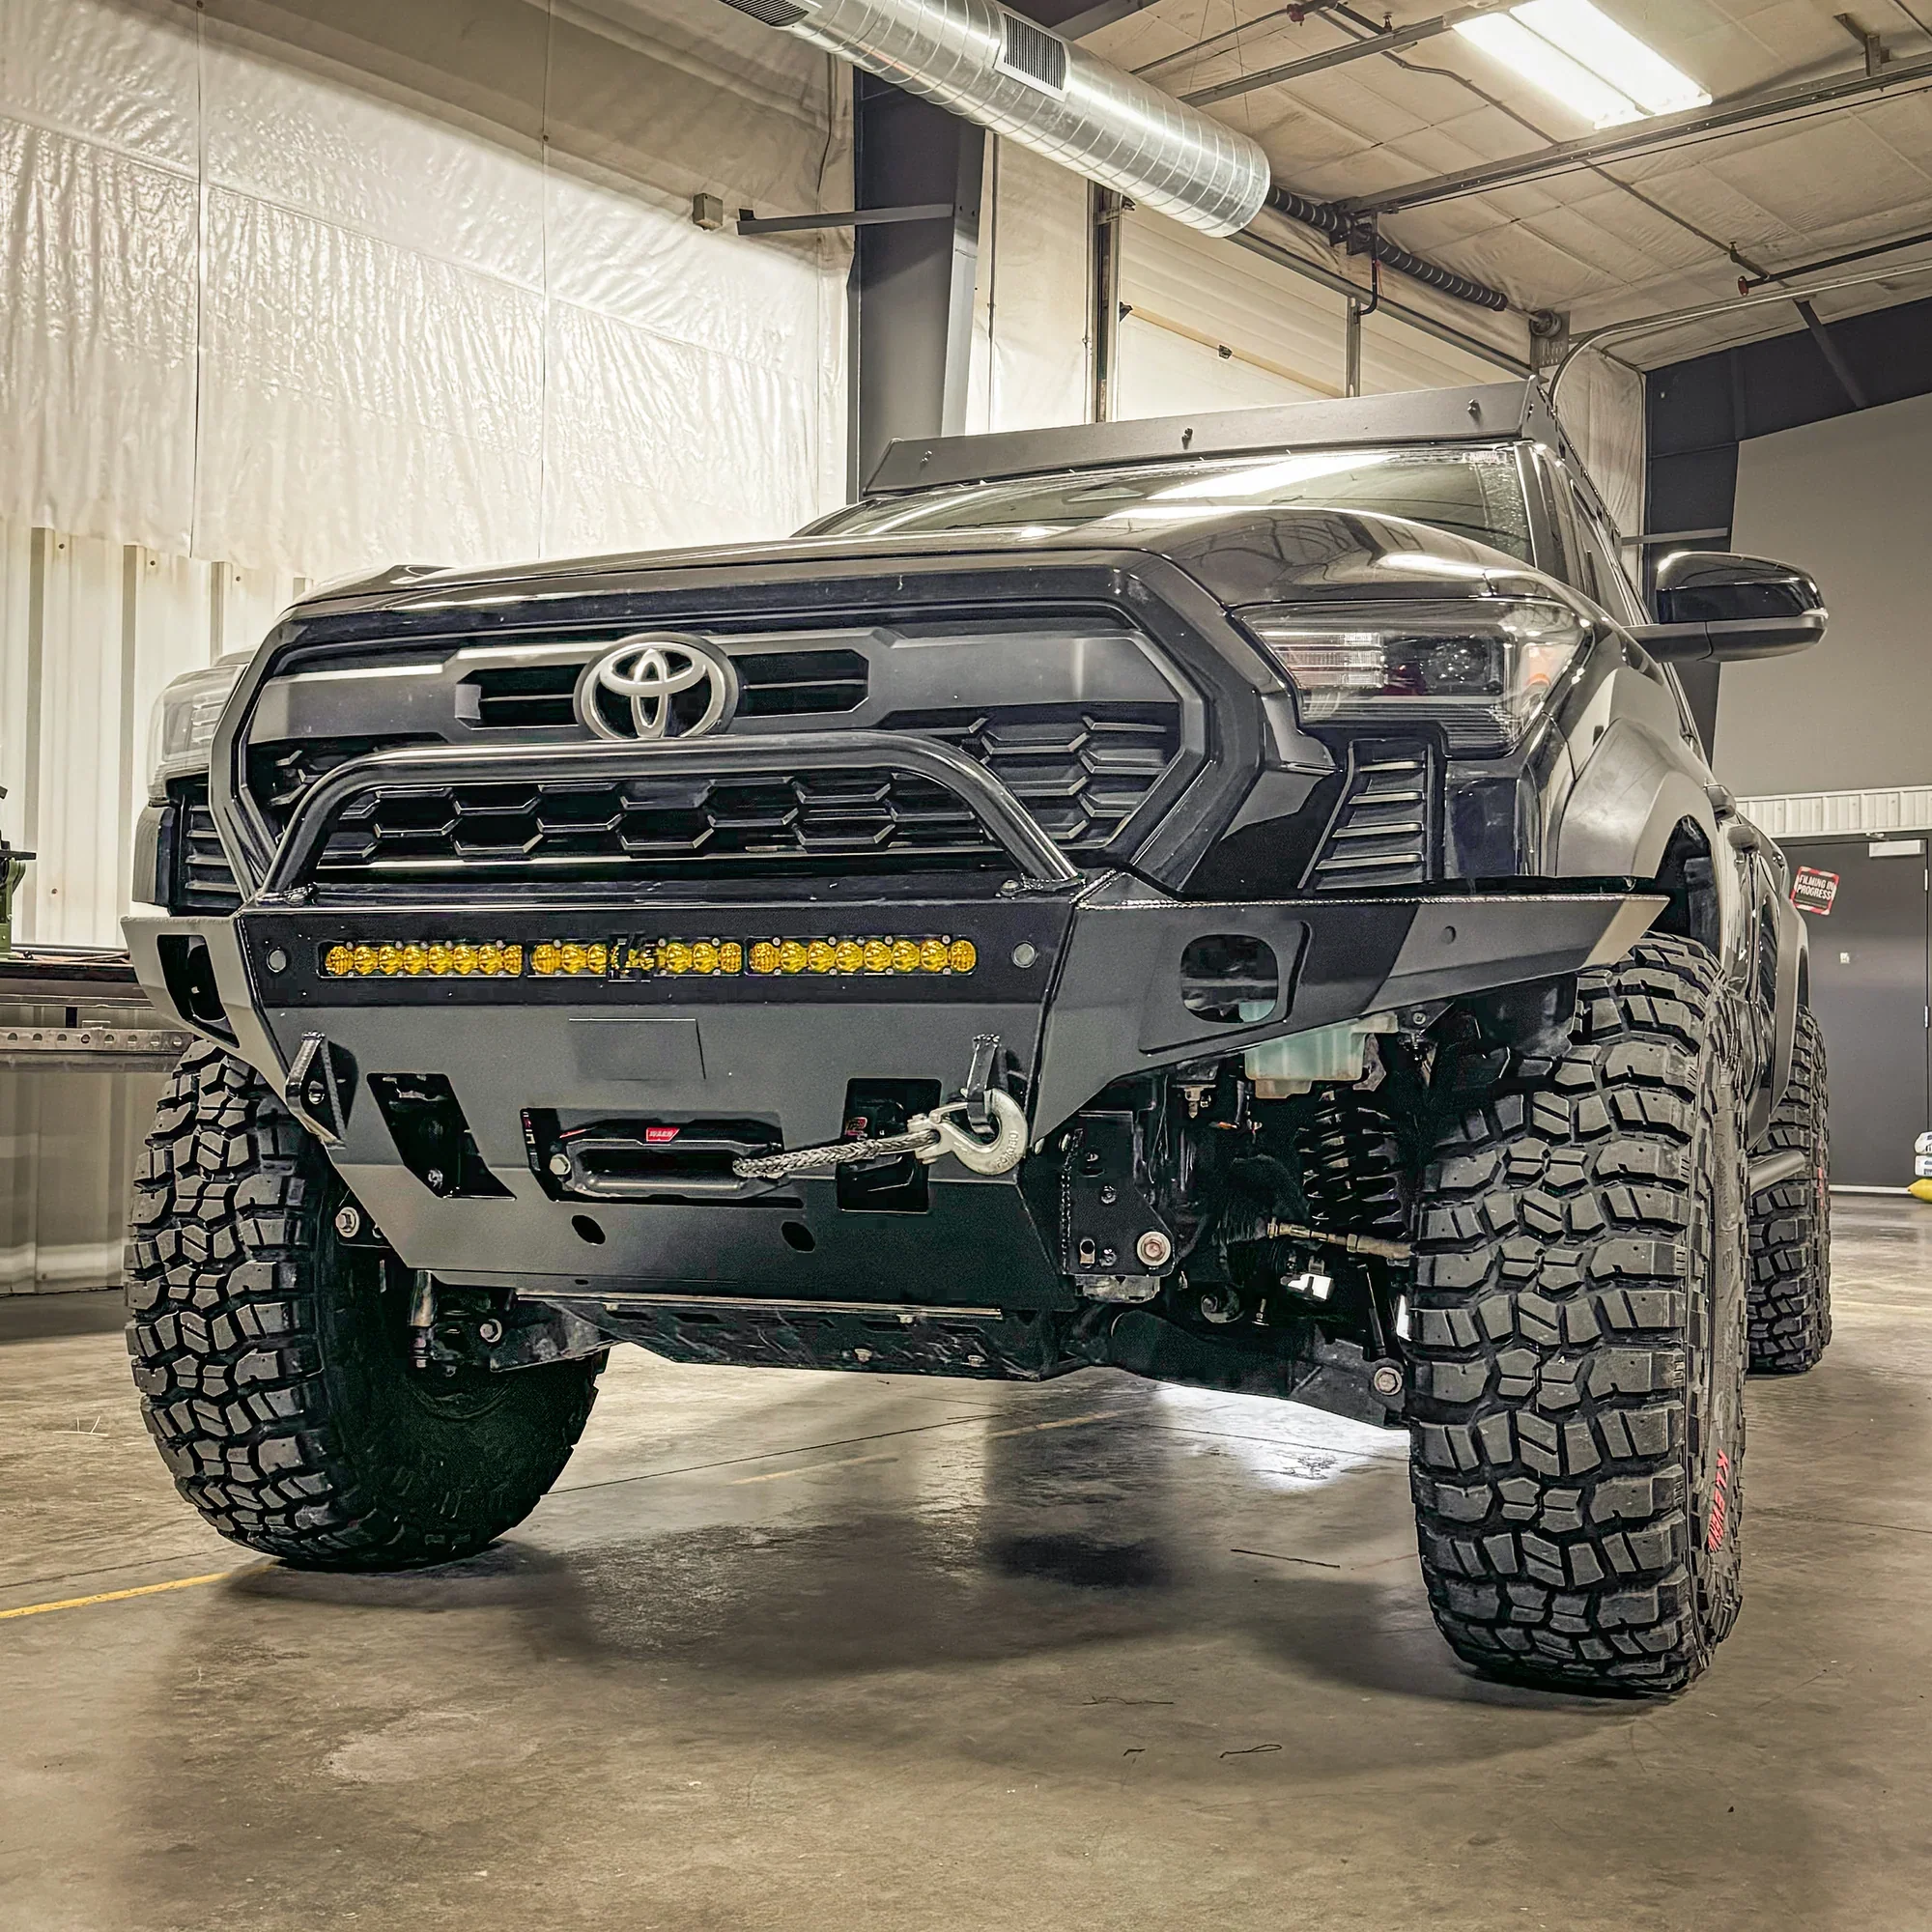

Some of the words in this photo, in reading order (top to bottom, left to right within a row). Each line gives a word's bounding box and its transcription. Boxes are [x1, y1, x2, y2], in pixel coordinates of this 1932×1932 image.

[1799, 874, 1826, 889] FILMING
[1826, 880, 1834, 891] IN
[1797, 884, 1833, 899] PROGRESS
